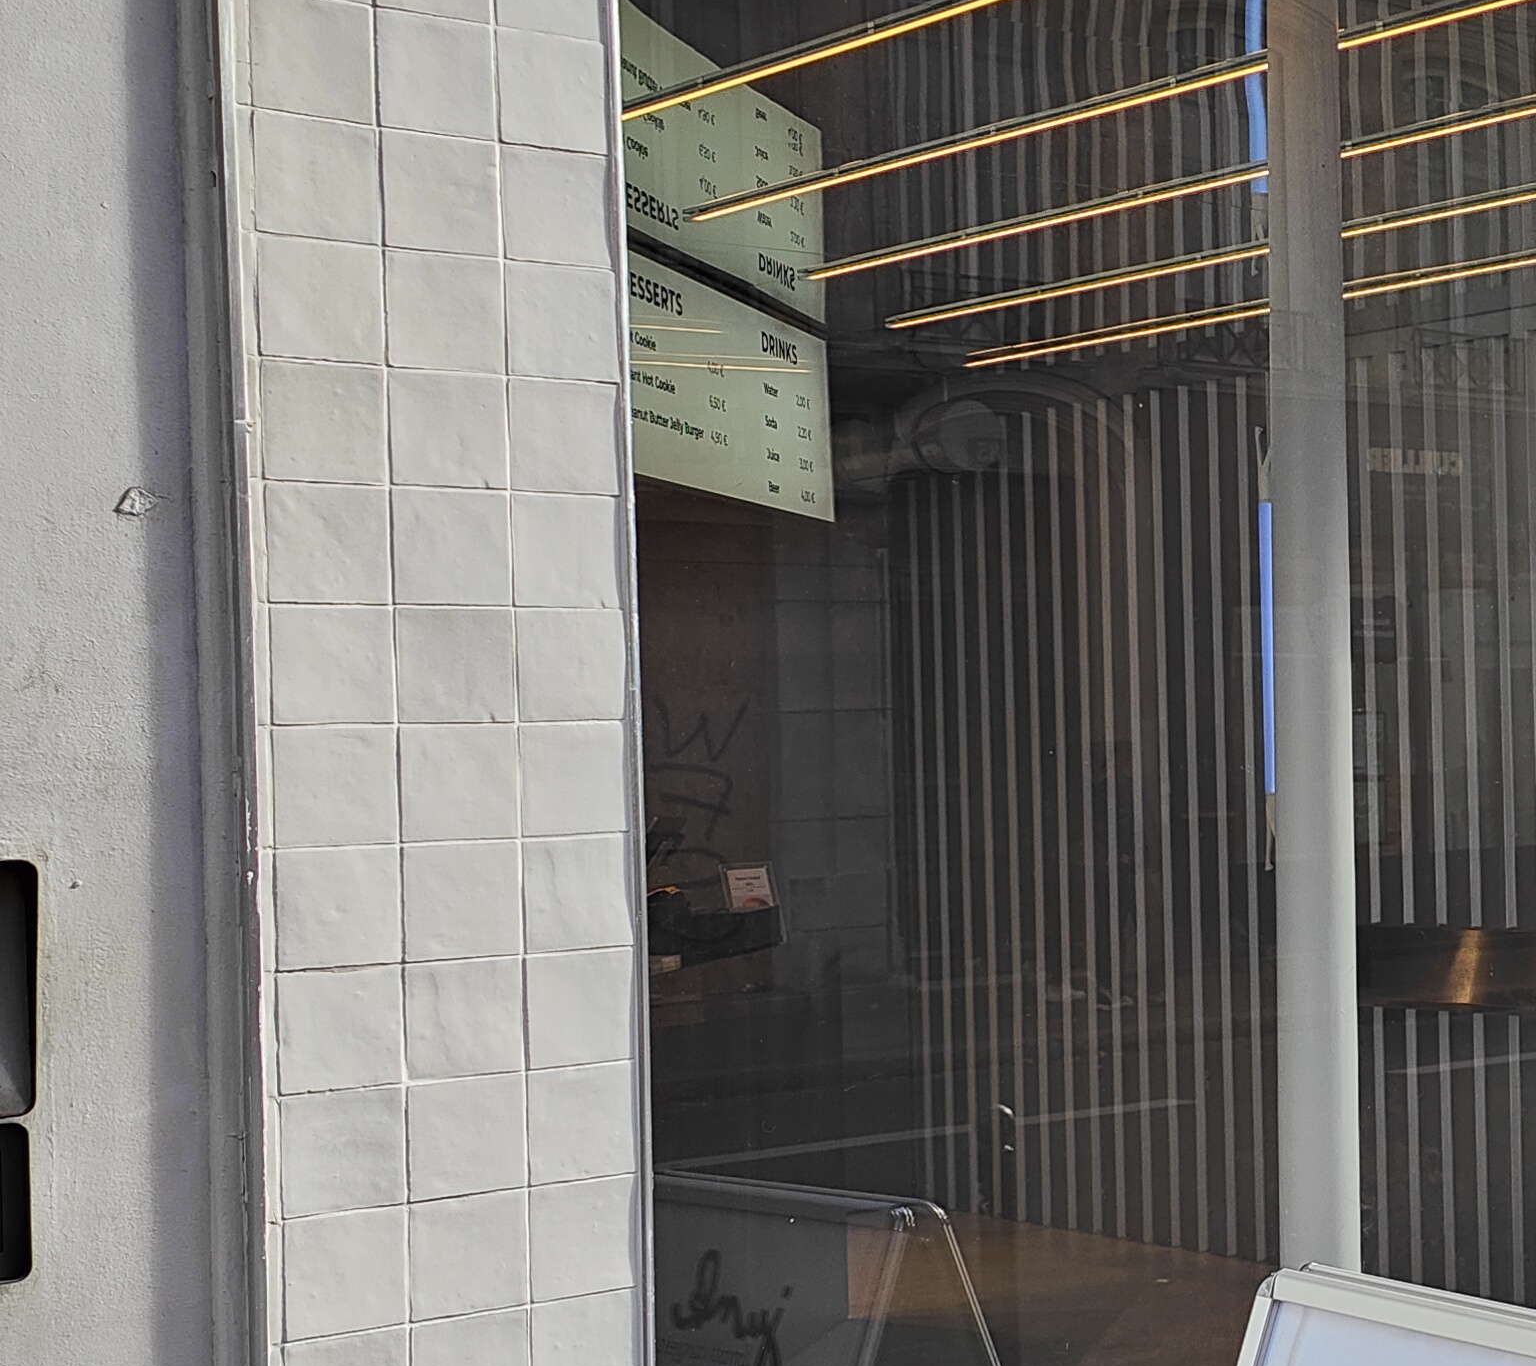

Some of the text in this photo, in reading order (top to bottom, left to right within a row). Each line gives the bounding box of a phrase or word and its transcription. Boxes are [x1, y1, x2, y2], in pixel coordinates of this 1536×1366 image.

[629, 271, 683, 316] ESSERTS
[761, 331, 798, 365] DRINKS
[655, 376, 676, 395] Cookie
